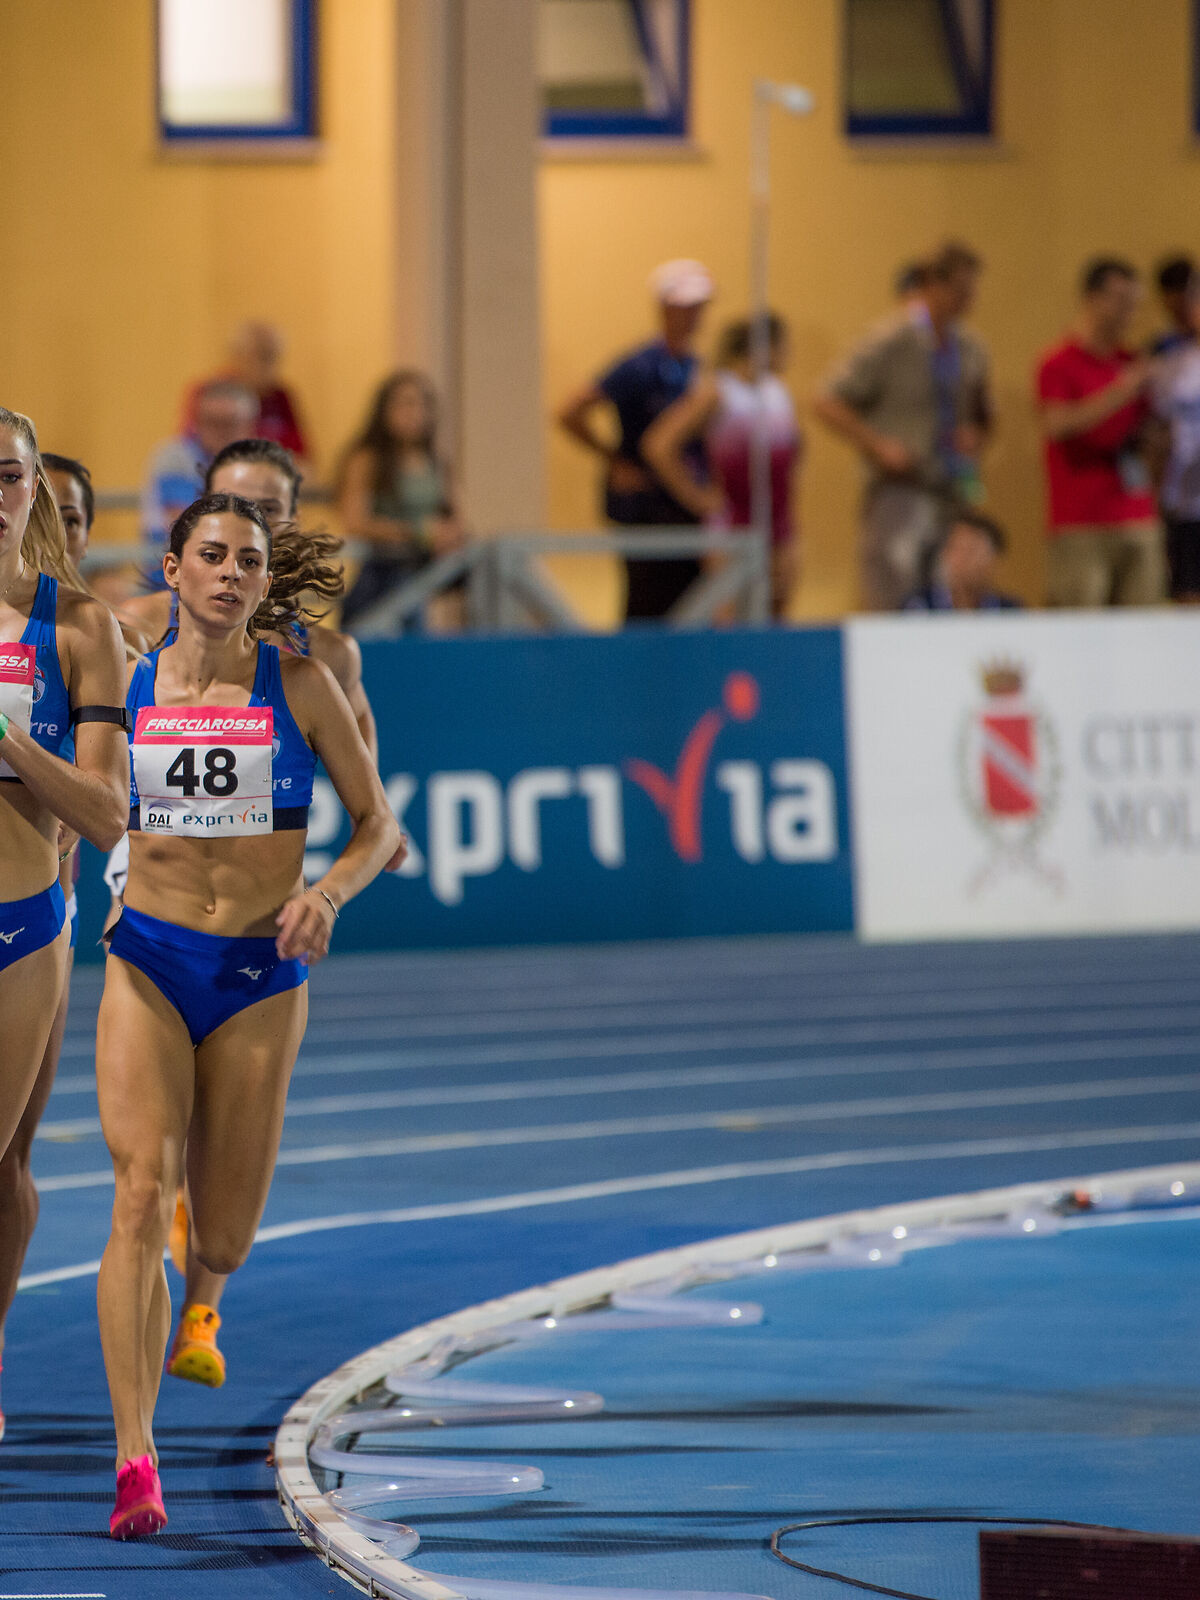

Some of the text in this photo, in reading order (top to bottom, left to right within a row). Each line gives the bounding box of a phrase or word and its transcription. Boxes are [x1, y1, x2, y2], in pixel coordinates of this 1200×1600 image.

[145, 718, 267, 731] FRECCIAROSSA
[166, 748, 238, 797] 48
[148, 804, 268, 828] DAI exprivia
